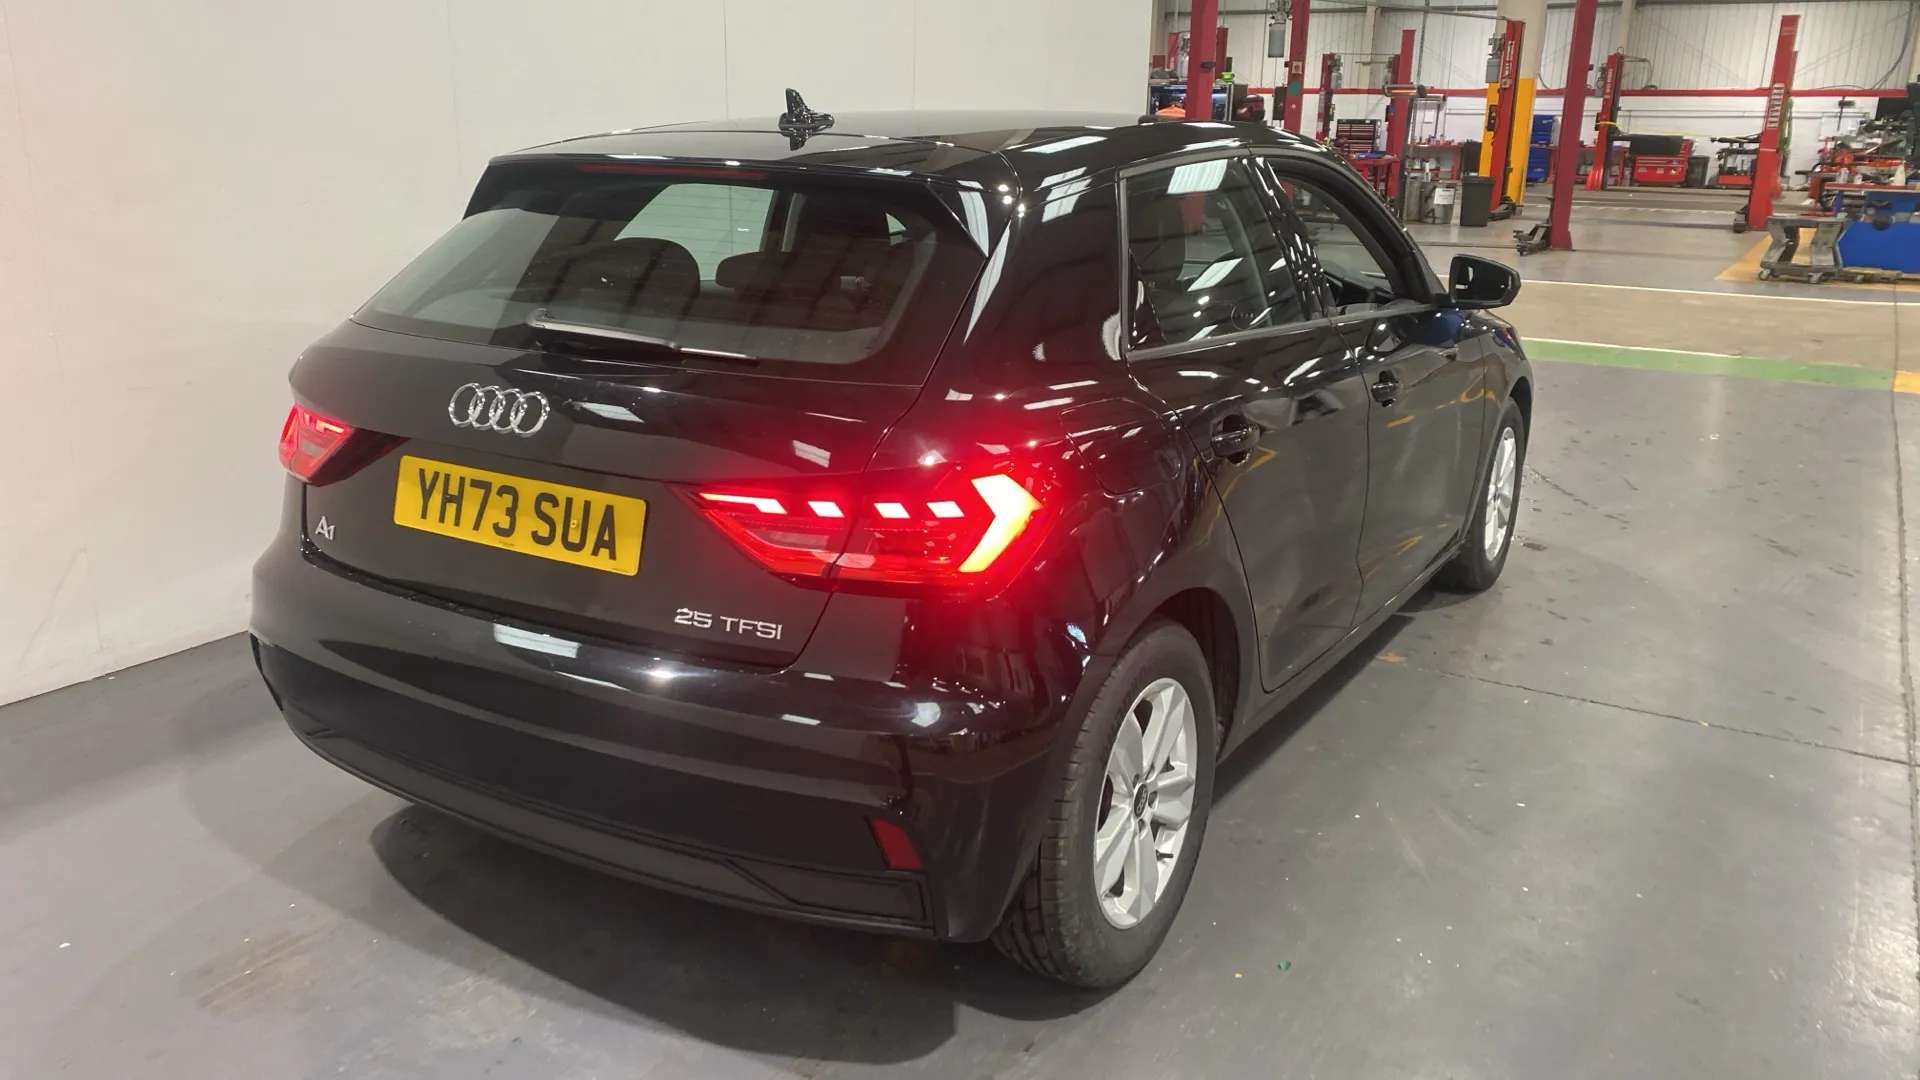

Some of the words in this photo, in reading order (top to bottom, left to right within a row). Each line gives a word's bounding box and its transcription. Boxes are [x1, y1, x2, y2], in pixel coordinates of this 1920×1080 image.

[314, 515, 336, 541] A1
[418, 468, 520, 538] YH73
[530, 491, 617, 561] SUA
[674, 607, 713, 629] 25
[719, 615, 783, 641] TFSI
